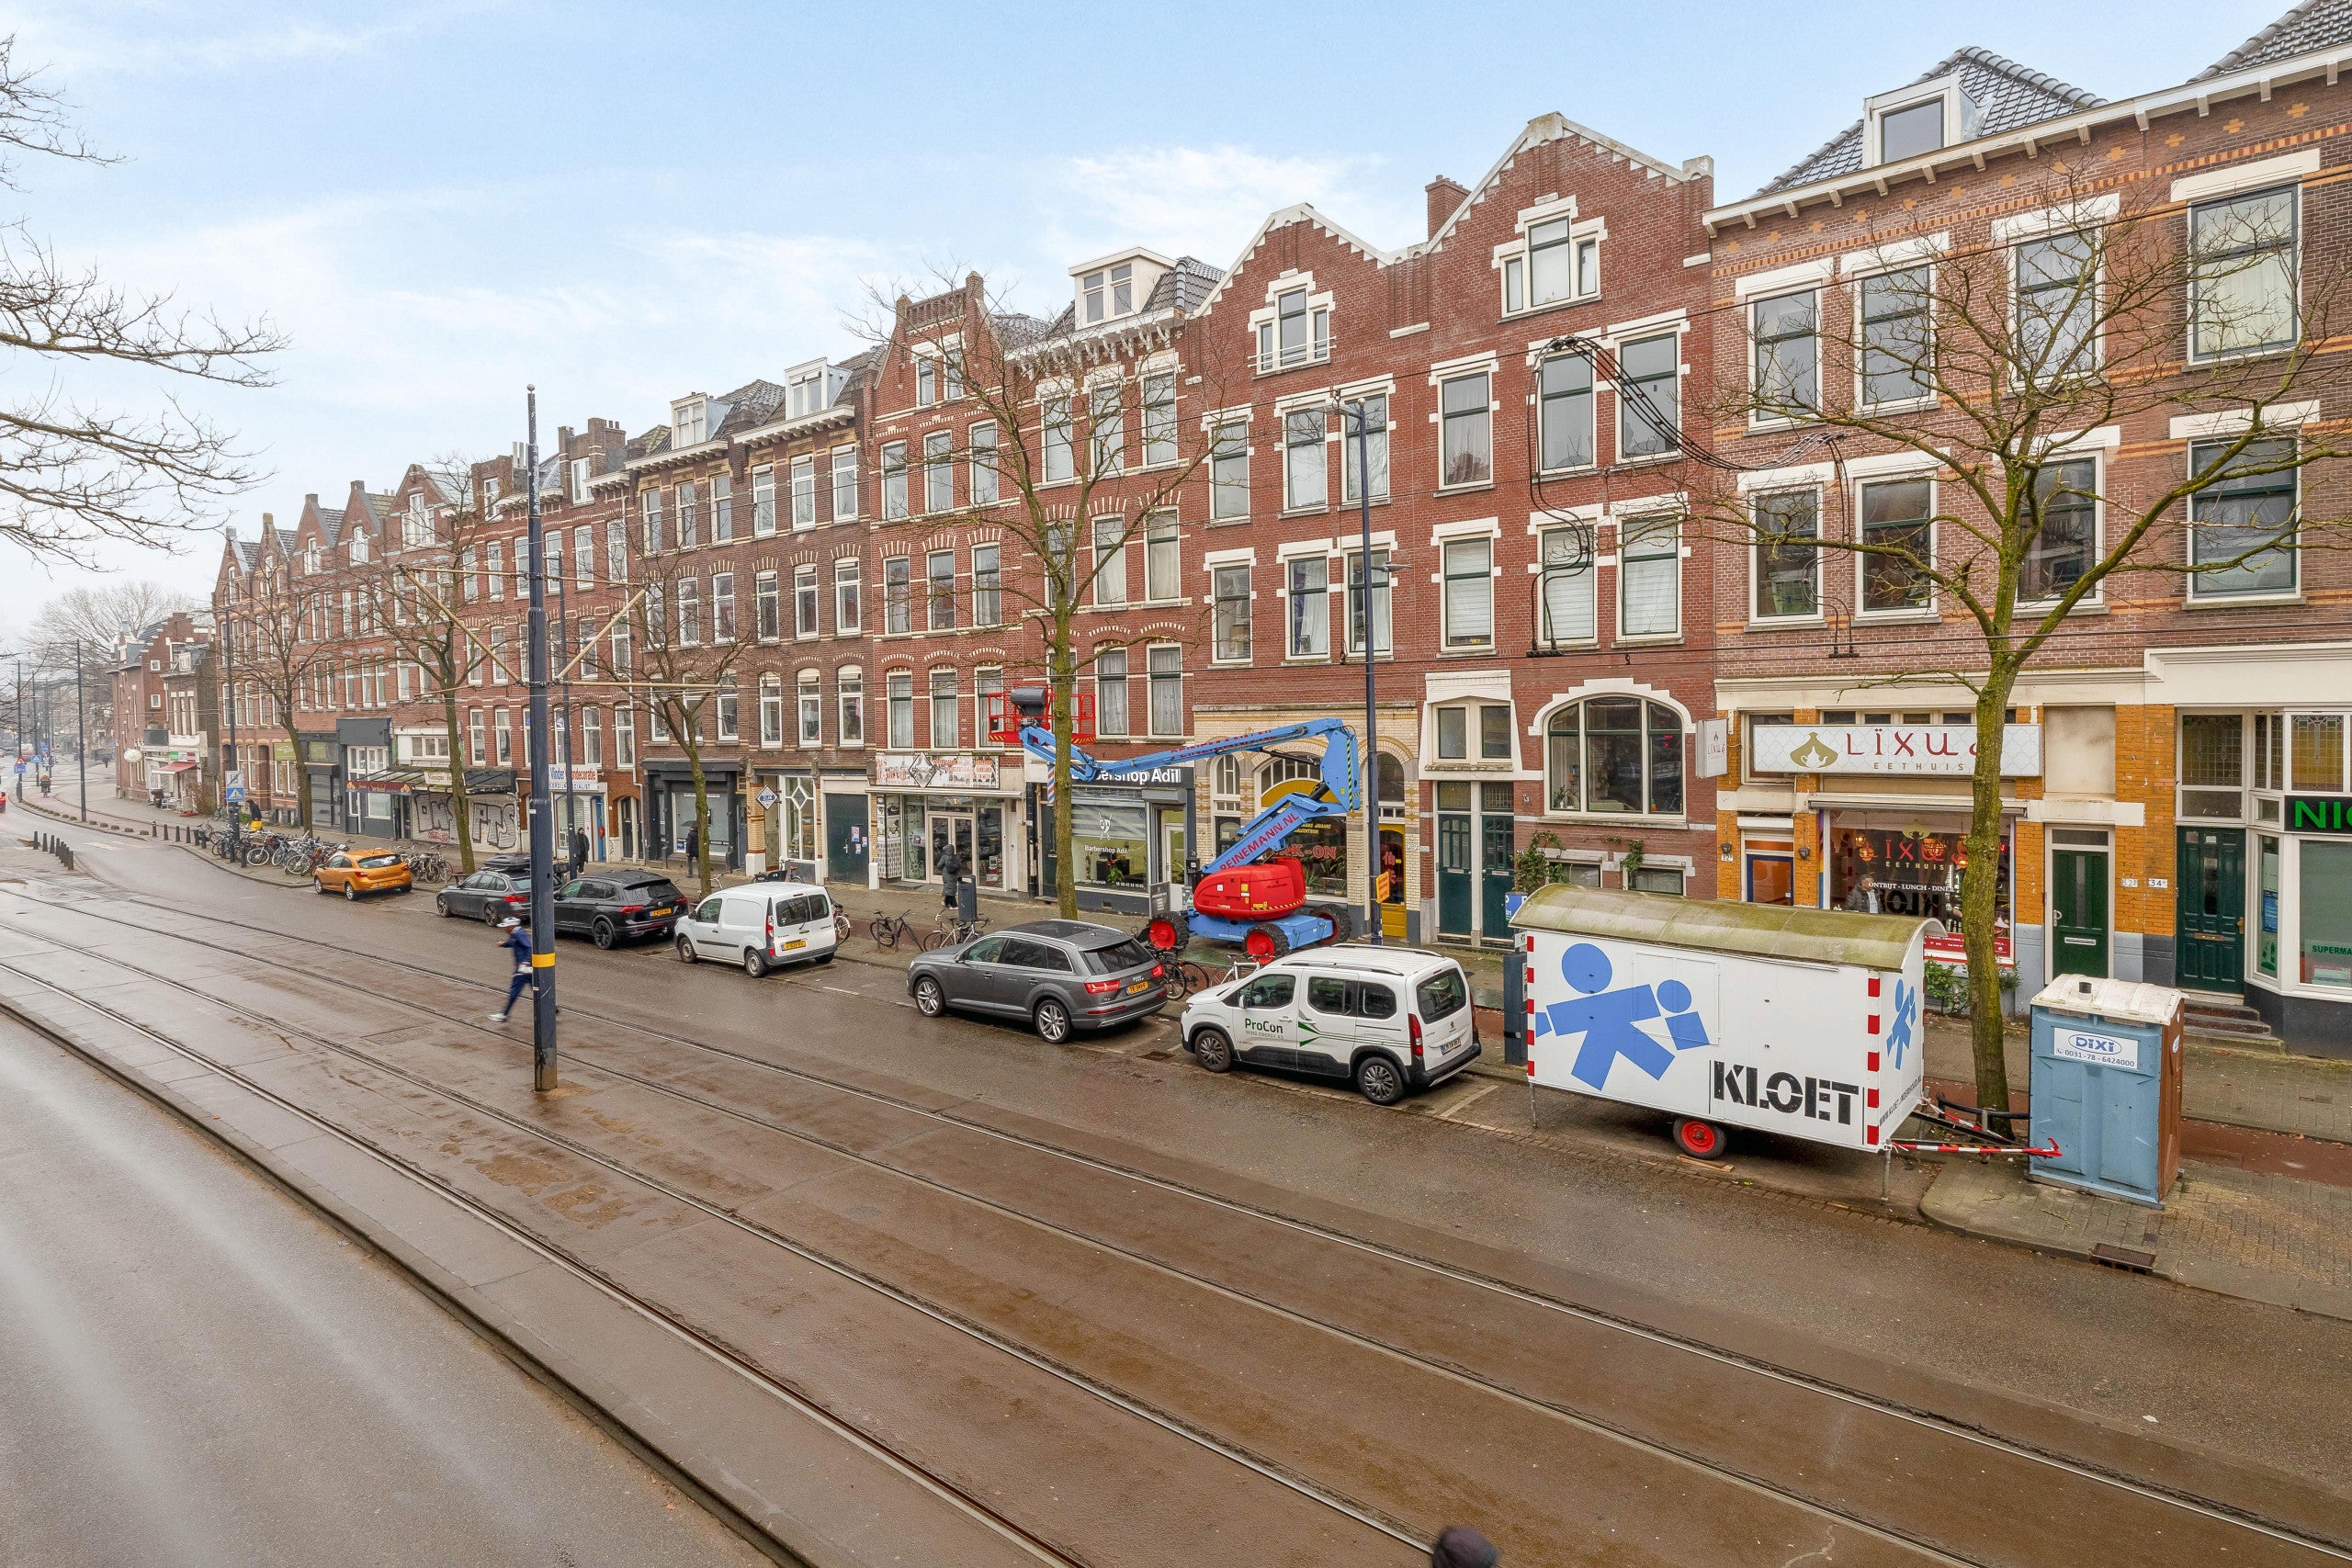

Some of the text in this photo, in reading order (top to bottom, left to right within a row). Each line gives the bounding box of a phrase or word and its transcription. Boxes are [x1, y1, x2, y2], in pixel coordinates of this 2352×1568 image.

[1873, 761, 1964, 772] EETHUIS
[1151, 768, 1182, 784] Adil
[2294, 800, 2352, 829] NI
[1084, 845, 1116, 853] Barbershop
[1885, 861, 1945, 871] EETHUIS
[1868, 881, 1897, 890] ONTBIJT
[1902, 884, 1927, 892] LUNCH
[1932, 885, 1954, 893] DINER
[1245, 1018, 1283, 1034] ProCon
[2064, 1049, 2082, 1058] 0031
[2101, 1056, 2135, 1067] 6424000
[1713, 1060, 1860, 1126] KLOET
